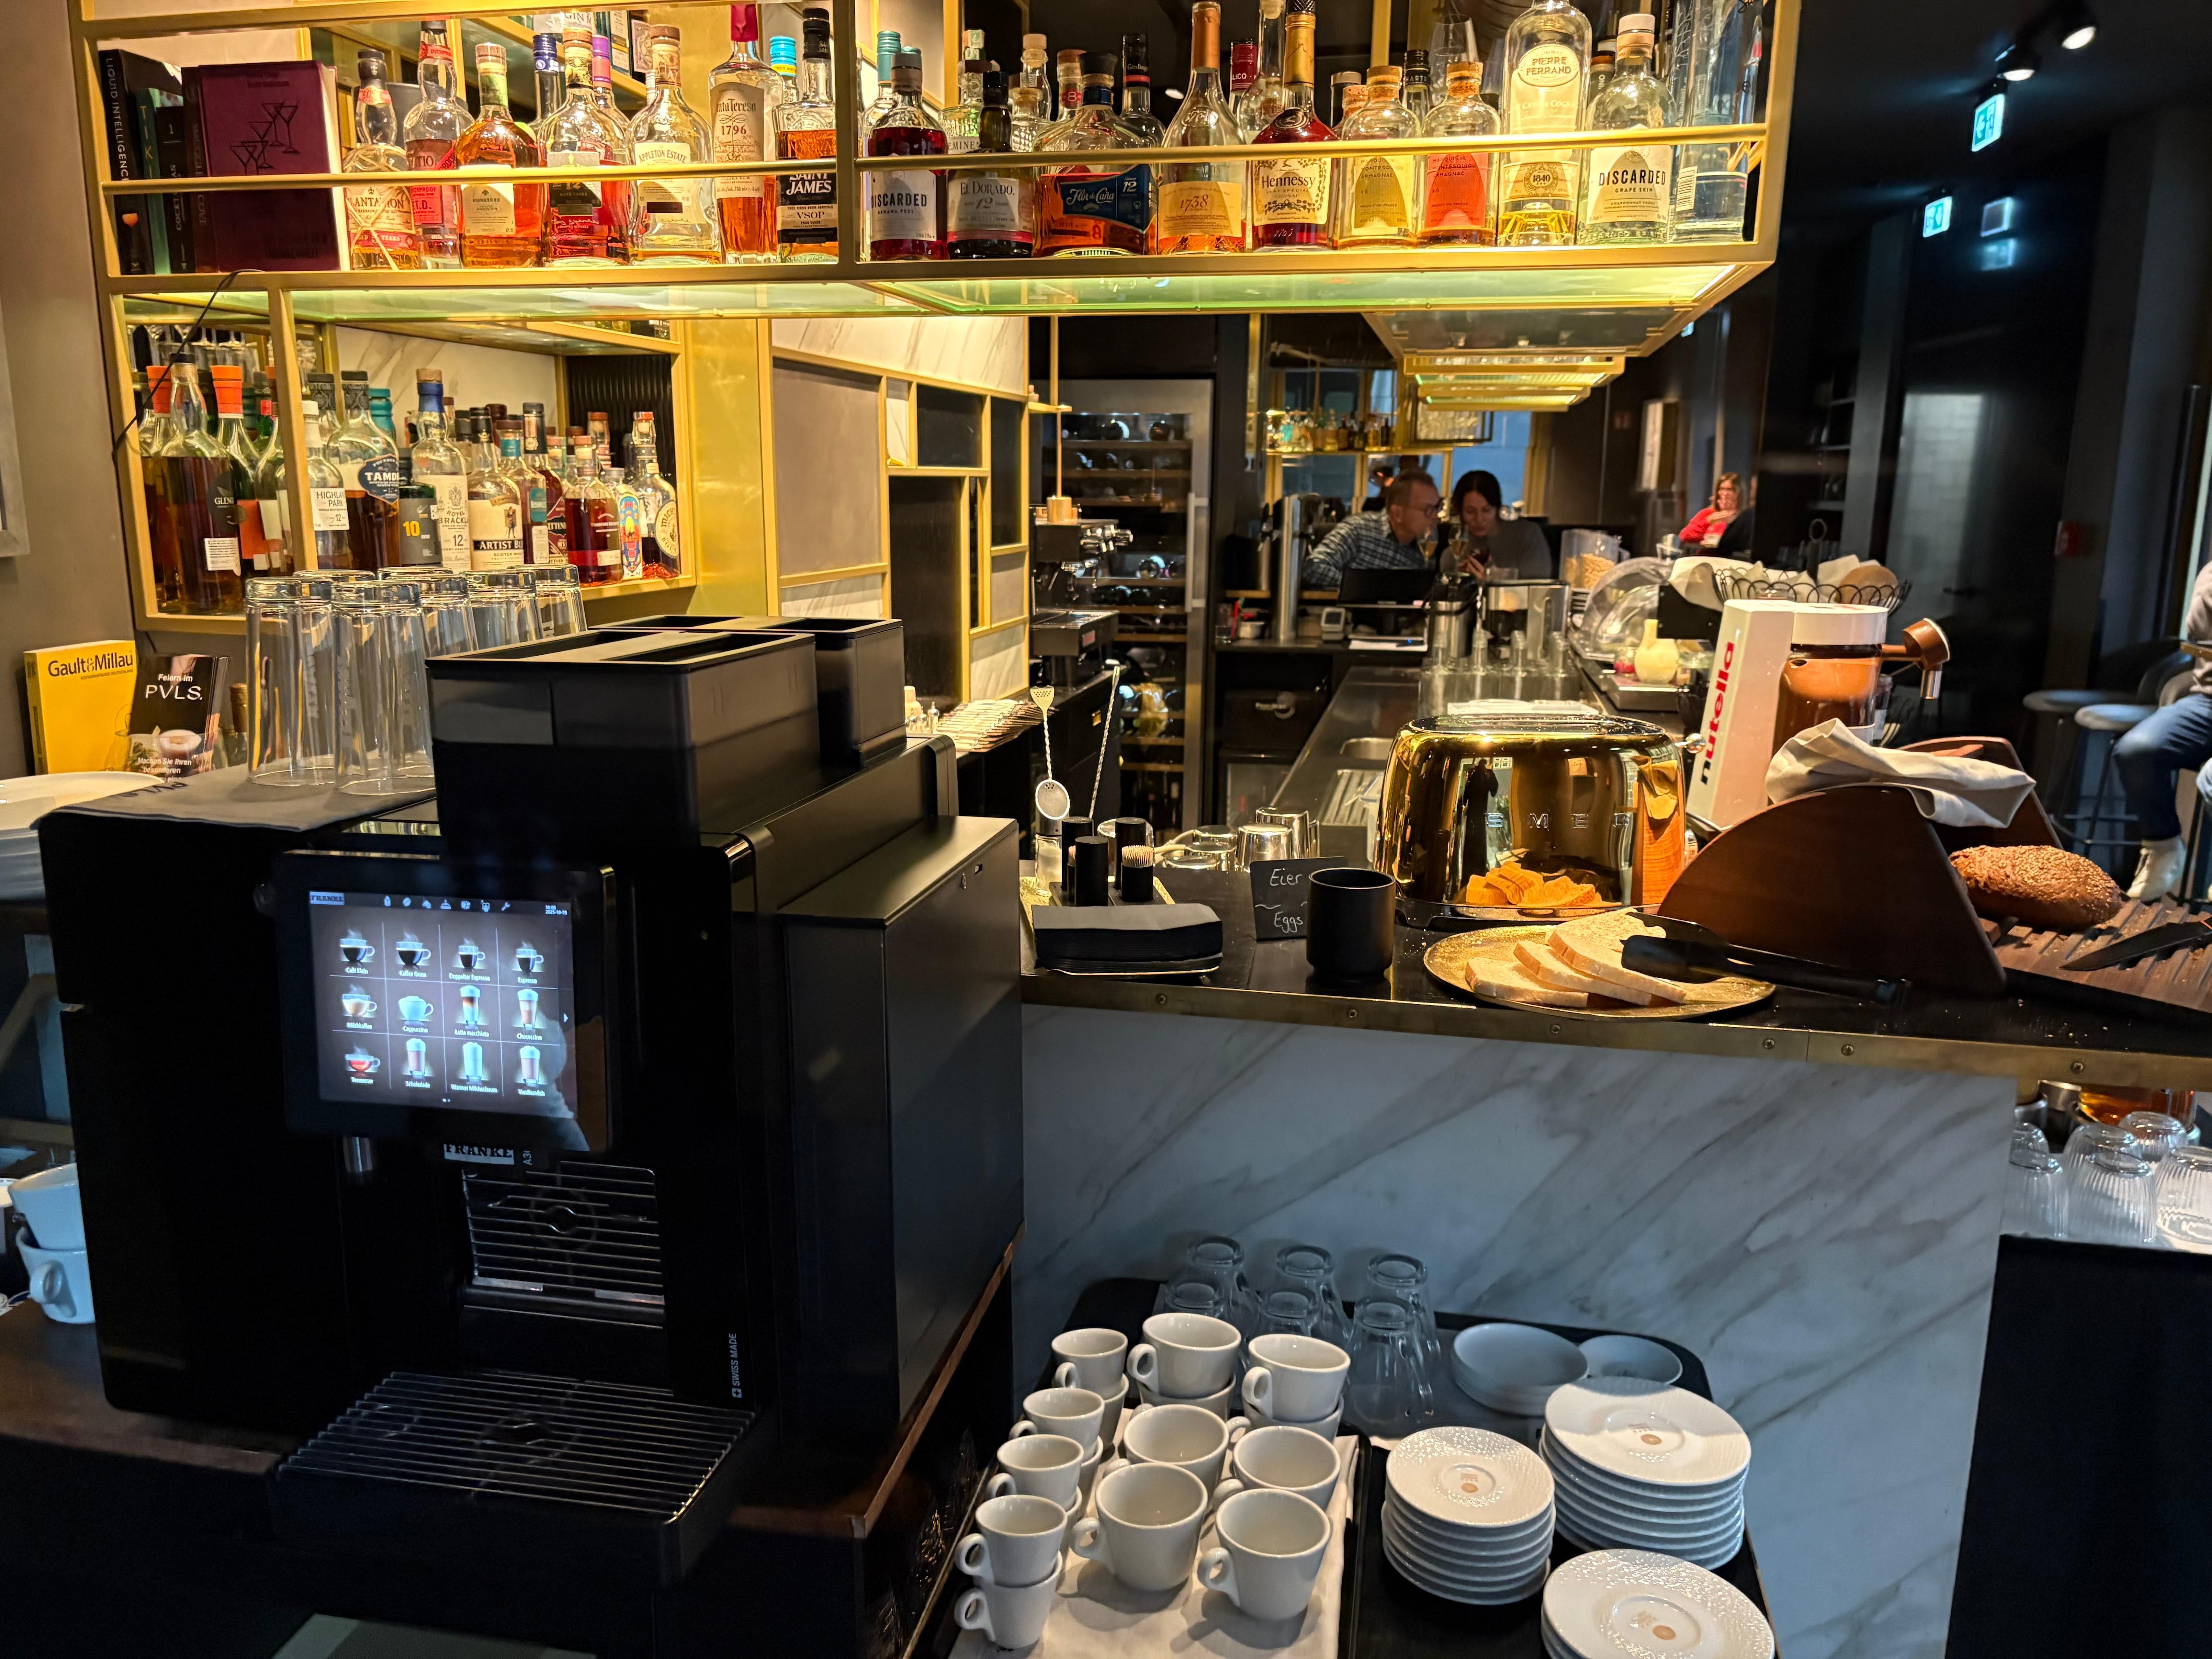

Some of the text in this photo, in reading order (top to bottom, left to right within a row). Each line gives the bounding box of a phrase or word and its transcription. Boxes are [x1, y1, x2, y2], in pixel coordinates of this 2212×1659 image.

[1532, 57, 1567, 65] PIERRE
[1526, 66, 1572, 76] FERRAND
[1068, 92, 1077, 102] 8
[106, 58, 129, 180] LIQUID INTELLIGENC
[722, 125, 747, 135] 1796
[638, 150, 687, 163] APPLETON ESTATE
[1262, 175, 1316, 188] Hennessy
[1532, 174, 1551, 183] 1840
[1599, 169, 1666, 186] DISCARDED
[786, 180, 832, 196] JAMES
[1122, 181, 1137, 192] 12
[872, 193, 927, 208] DISCARDED
[1066, 188, 1089, 205] Flor
[1095, 187, 1115, 204] Caña
[975, 197, 993, 209] 12
[1179, 194, 1209, 212] 1738
[403, 521, 420, 537] 10
[453, 534, 464, 546] 12
[480, 541, 512, 549] ARTIST
[158, 673, 182, 682] Feiern
[145, 684, 203, 700] PVLS.
[1700, 641, 1735, 785] nutella
[174, 757, 192, 766] Ihren
[1270, 868, 1302, 887] Eier
[1274, 911, 1303, 933] Eggs
[446, 1144, 512, 1158] FRANKE
[729, 1333, 740, 1386] SWISS MADE
